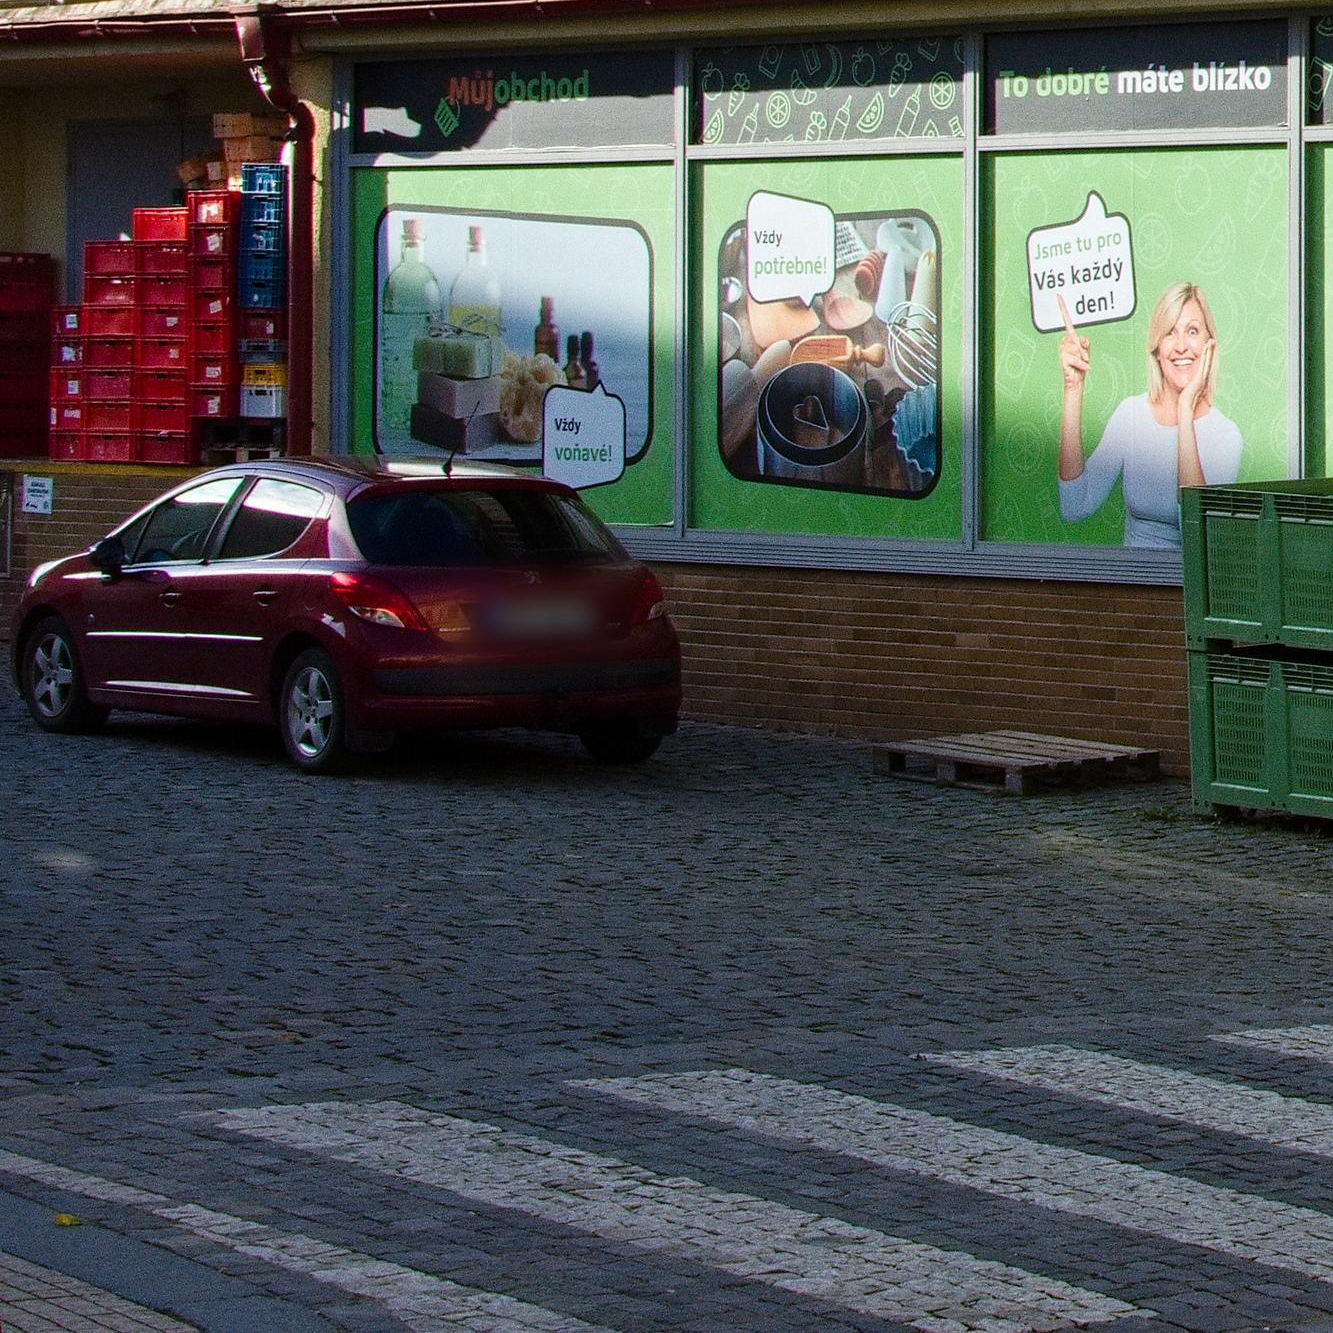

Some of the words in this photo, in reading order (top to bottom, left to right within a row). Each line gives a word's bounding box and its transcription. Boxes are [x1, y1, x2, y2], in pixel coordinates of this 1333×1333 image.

[999, 70, 1029, 98] To
[1036, 66, 1109, 97] dobré
[1116, 63, 1185, 94] máte
[1192, 60, 1272, 92] blízko
[754, 229, 783, 248] Vždy
[1035, 241, 1072, 260] Jsme
[1076, 237, 1092, 252] tu
[1097, 232, 1122, 252] pro
[754, 256, 827, 279] potřebné!
[1034, 268, 1065, 291] Vás
[1070, 257, 1123, 285] každý
[1075, 291, 1115, 315] den!
[554, 417, 581, 435] Vždy
[554, 443, 612, 462] voňavé!
